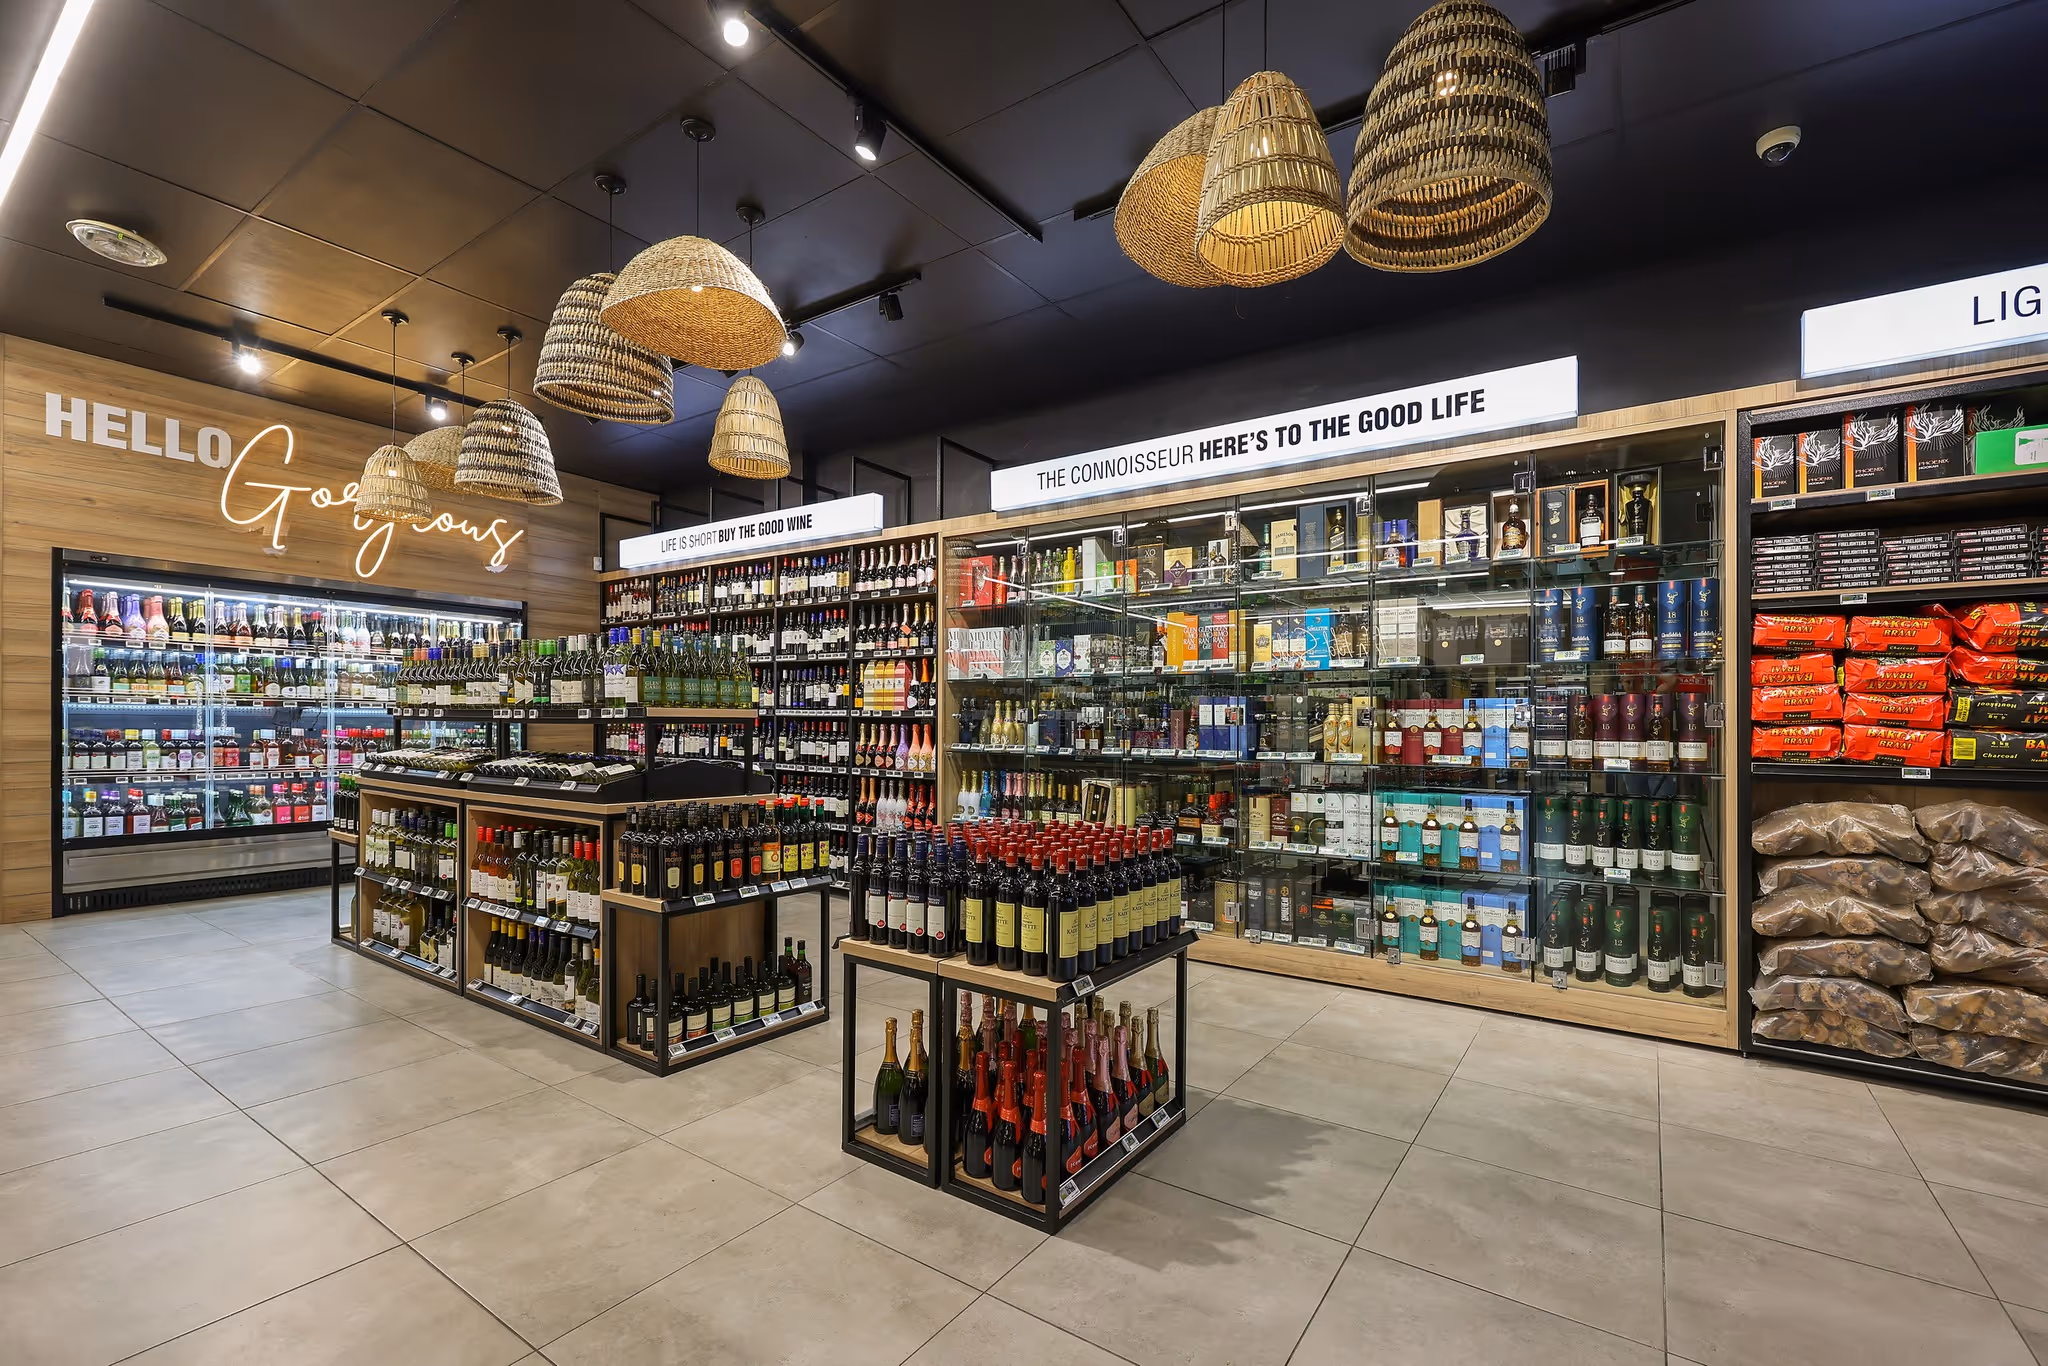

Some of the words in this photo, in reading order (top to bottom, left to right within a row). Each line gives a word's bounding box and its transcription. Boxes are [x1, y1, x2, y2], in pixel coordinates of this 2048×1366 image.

[1973, 285, 2041, 326] LIG
[45, 392, 232, 469] HELLO
[1037, 471, 1066, 491] THE
[1071, 445, 1194, 486] CONNOISSEUR
[1199, 429, 1268, 461] HERE'S
[1275, 422, 1301, 447] TO
[1309, 414, 1350, 442] THE
[1359, 400, 1422, 434] GOOD
[1432, 388, 1485, 421] LIFE
[661, 537, 677, 553] LIFE
[679, 536, 687, 550] IS
[689, 530, 717, 548] SHORT
[718, 527, 736, 543] BUY
[739, 523, 756, 540] THE
[759, 518, 783, 536] GOOD
[787, 513, 813, 532] WINE
[1700, 609, 1709, 617] 18
[1688, 723, 1697, 731] 15
[1679, 835, 1689, 843] 12
[1613, 939, 1623, 947] 12
